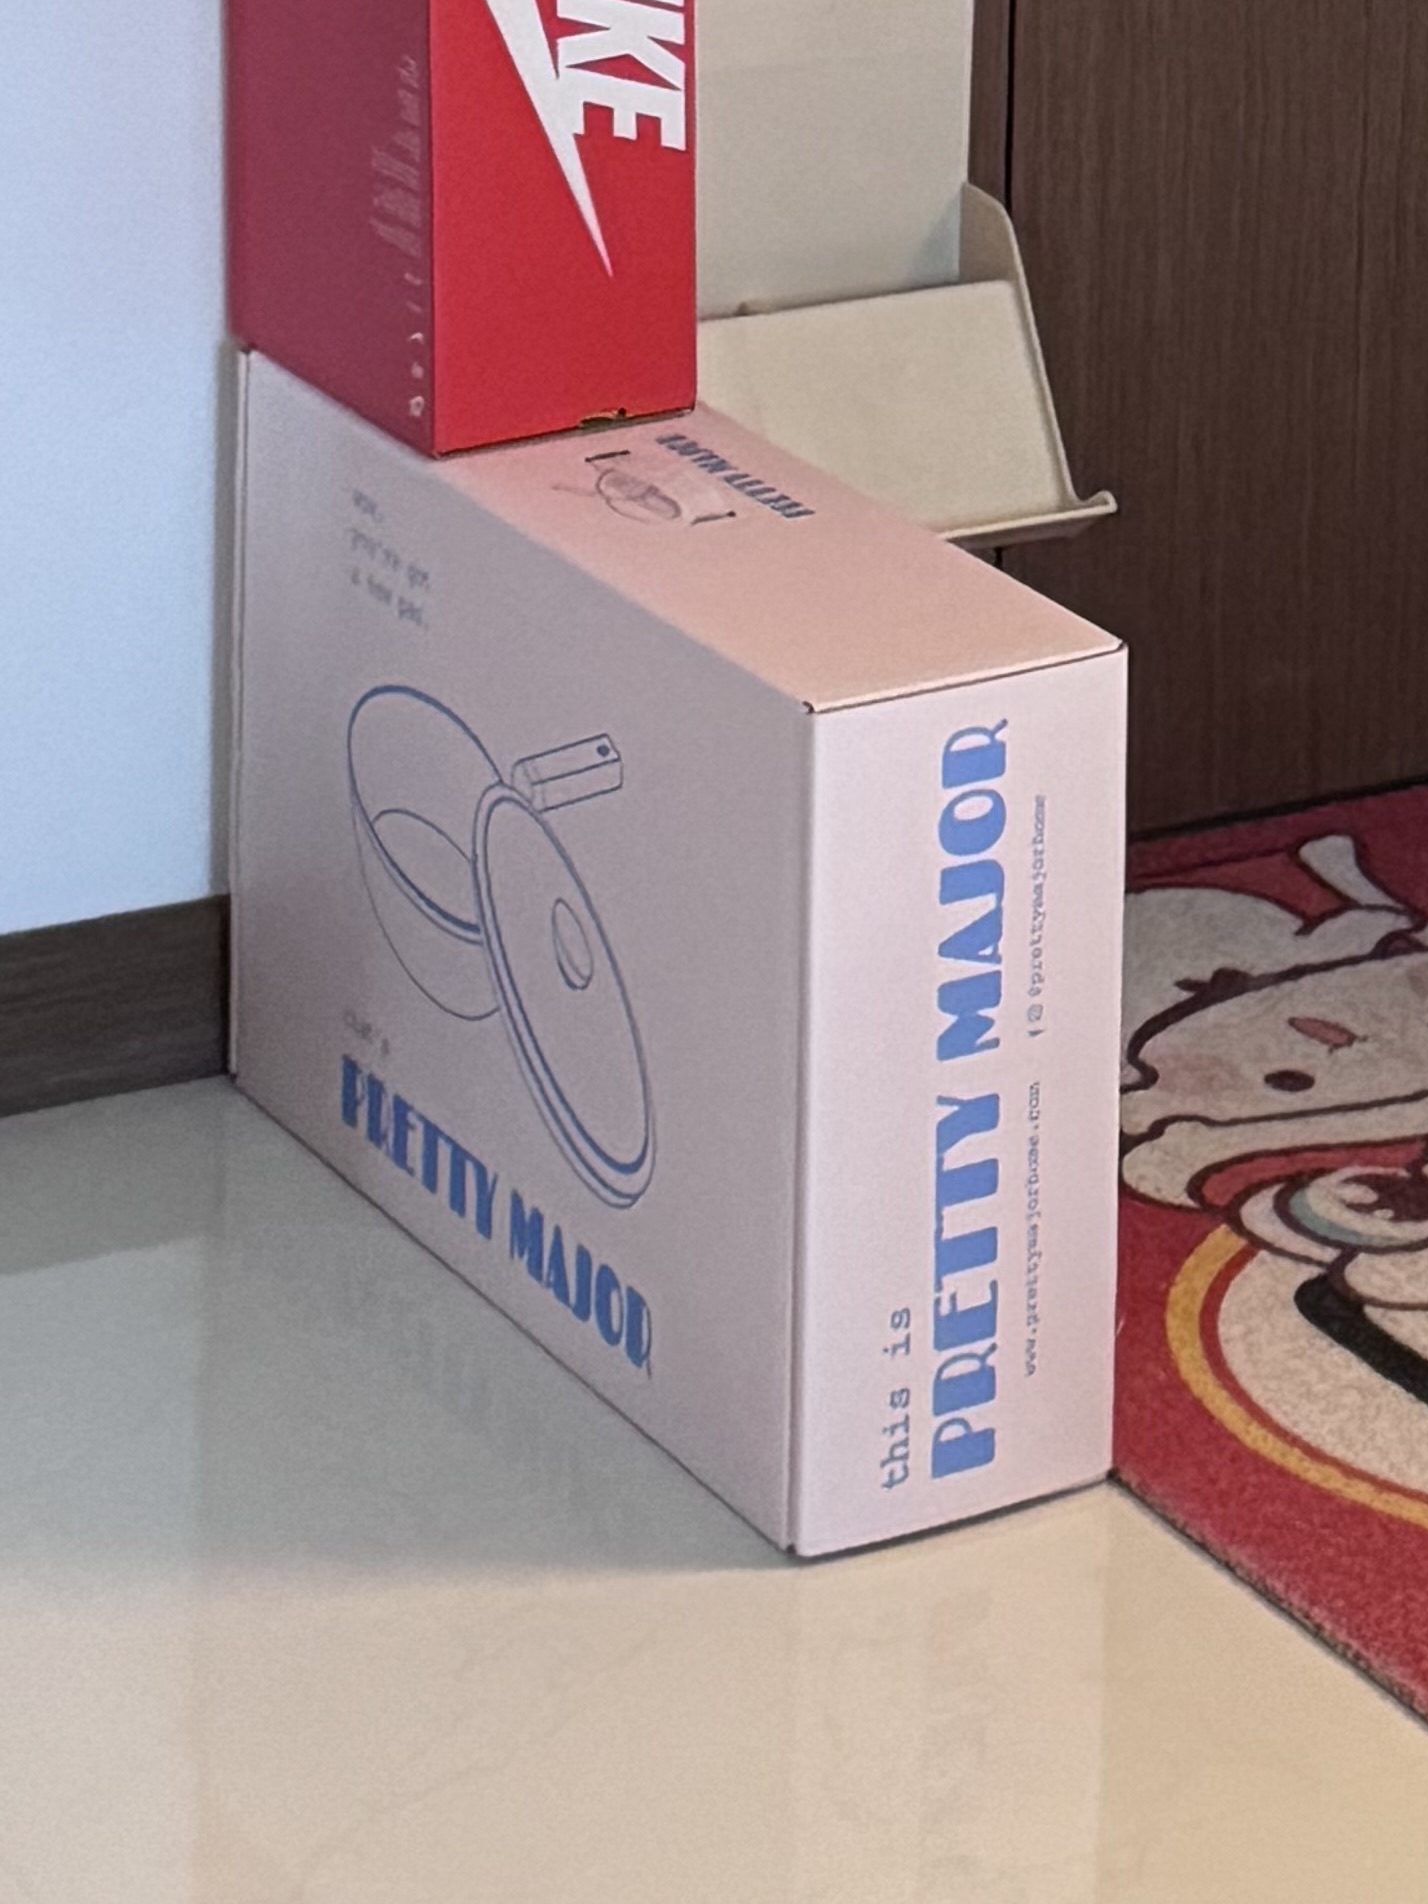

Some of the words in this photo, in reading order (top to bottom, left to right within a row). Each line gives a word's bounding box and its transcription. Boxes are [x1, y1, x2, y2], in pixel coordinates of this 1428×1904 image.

[934, 717, 1010, 1064] MAJOR
[340, 1053, 500, 1241] PRETTY
[509, 1188, 652, 1380] MAJOR
[882, 1306, 912, 1360] is
[930, 1091, 1001, 1481] PRETTY
[879, 1386, 911, 1491] this
